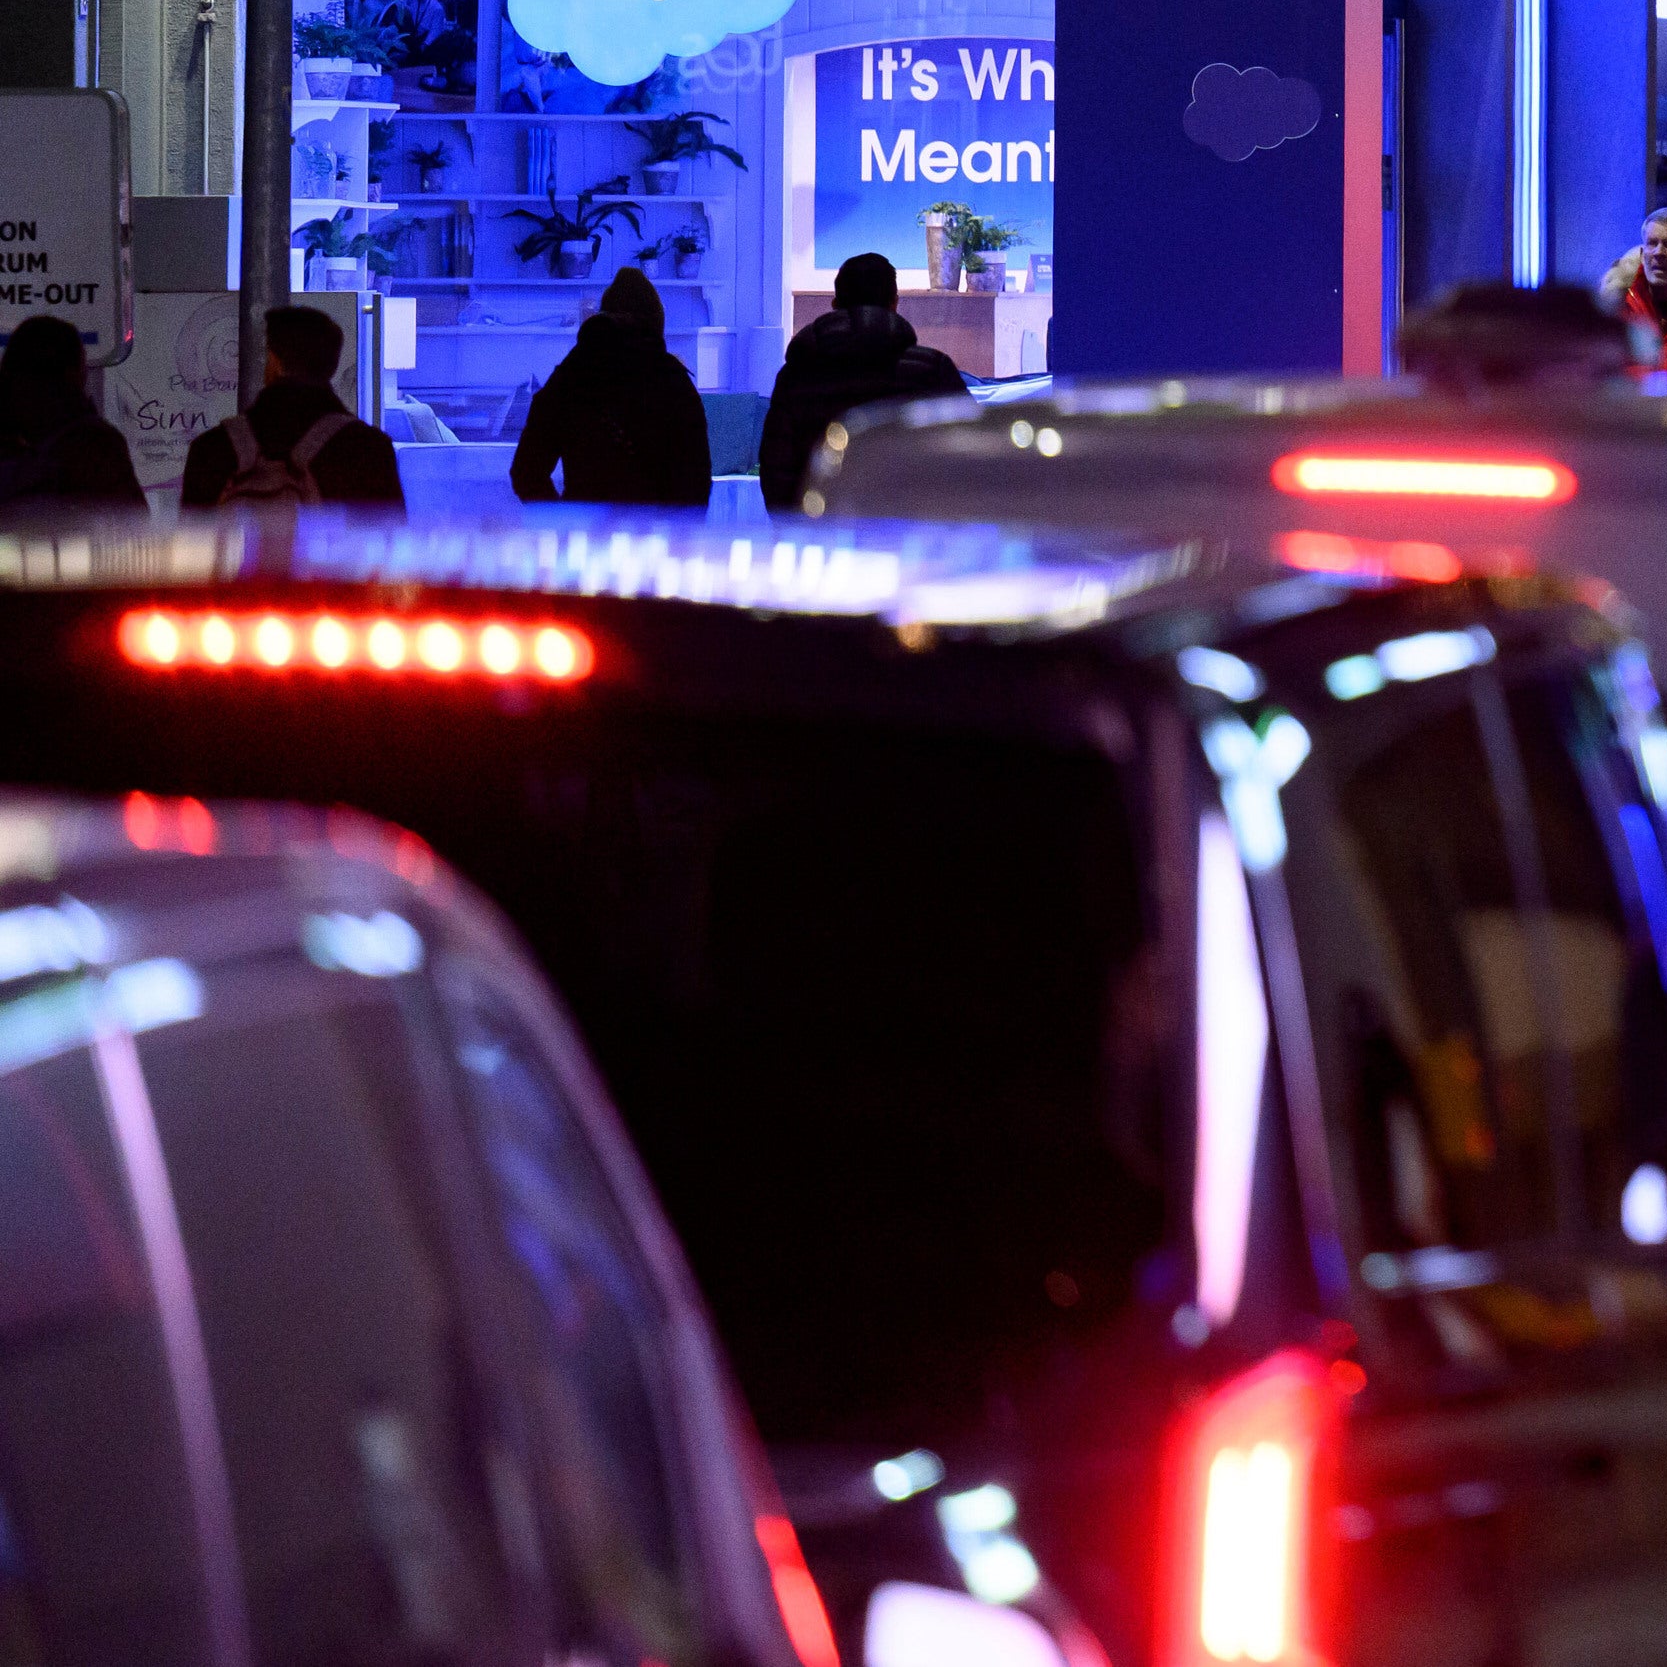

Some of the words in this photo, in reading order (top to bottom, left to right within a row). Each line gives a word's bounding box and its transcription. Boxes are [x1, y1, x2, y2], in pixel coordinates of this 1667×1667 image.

[861, 47, 939, 102] It's
[957, 47, 1055, 102] Wh
[0, 220, 36, 242] ON
[137, 399, 209, 431] Sinn
